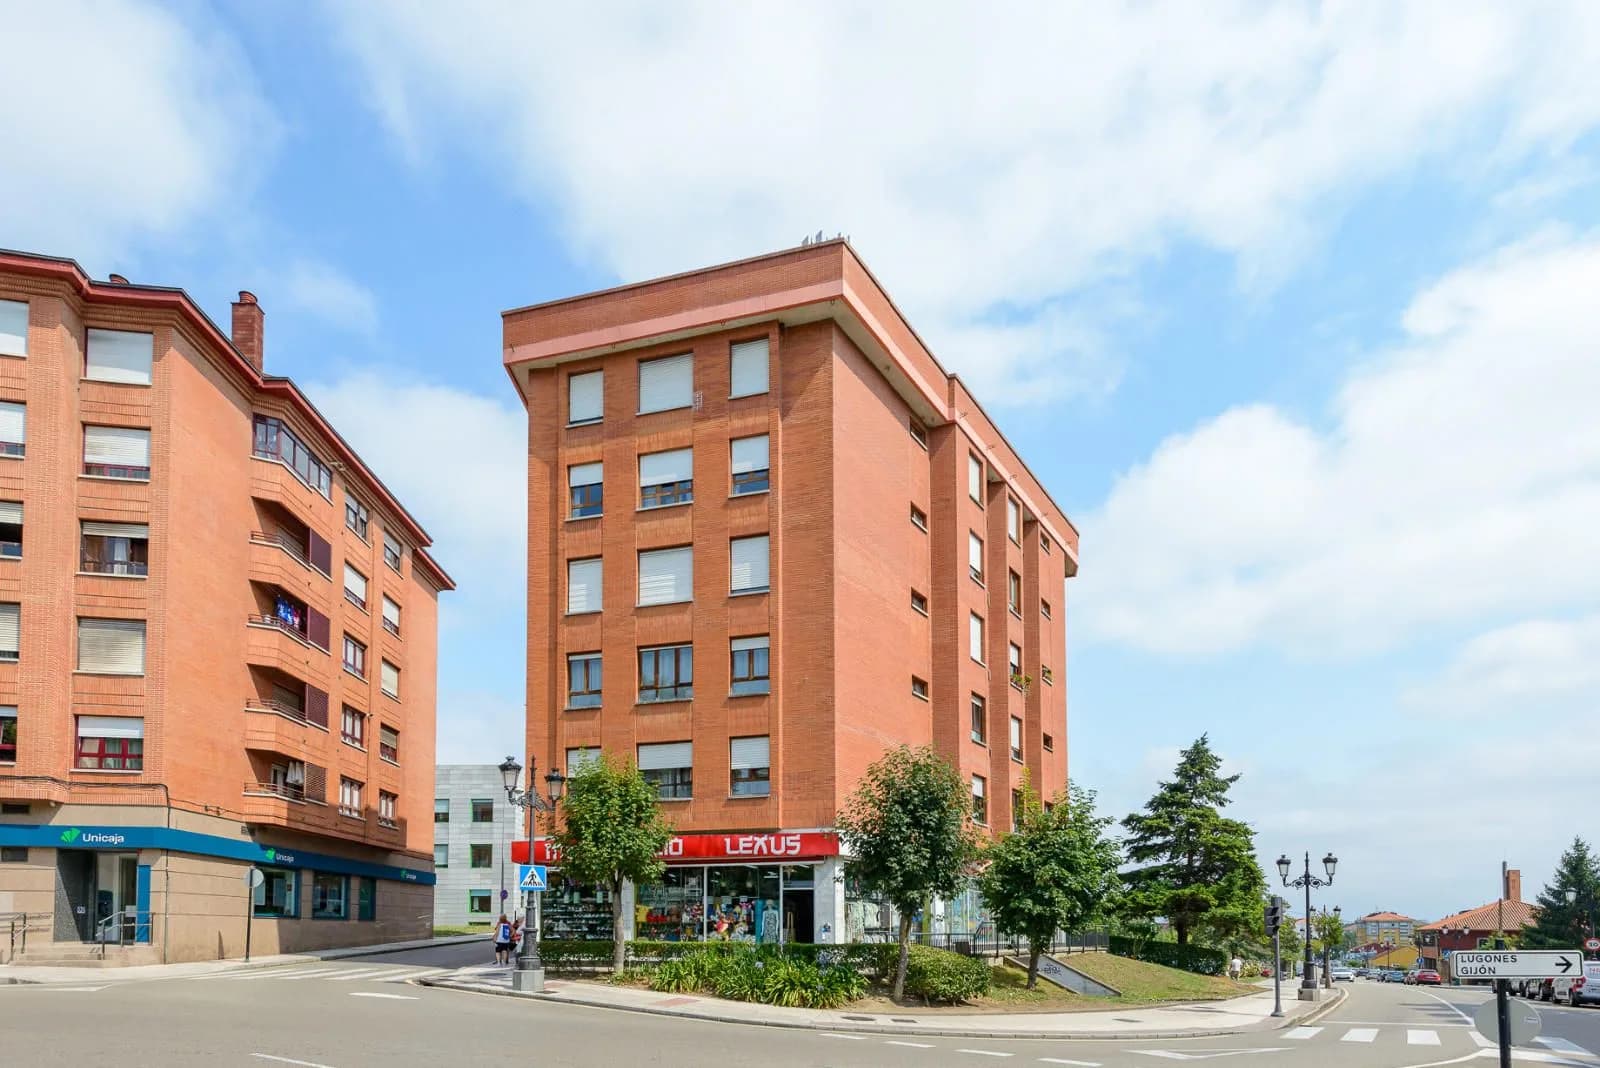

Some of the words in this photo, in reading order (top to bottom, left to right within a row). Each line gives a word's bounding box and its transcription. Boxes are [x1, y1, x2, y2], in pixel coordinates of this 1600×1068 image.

[82, 833, 125, 844] Unicaja
[724, 835, 801, 855] LEXUS
[1460, 954, 1518, 963] LUGONES
[1460, 964, 1496, 975] GIJÓN
